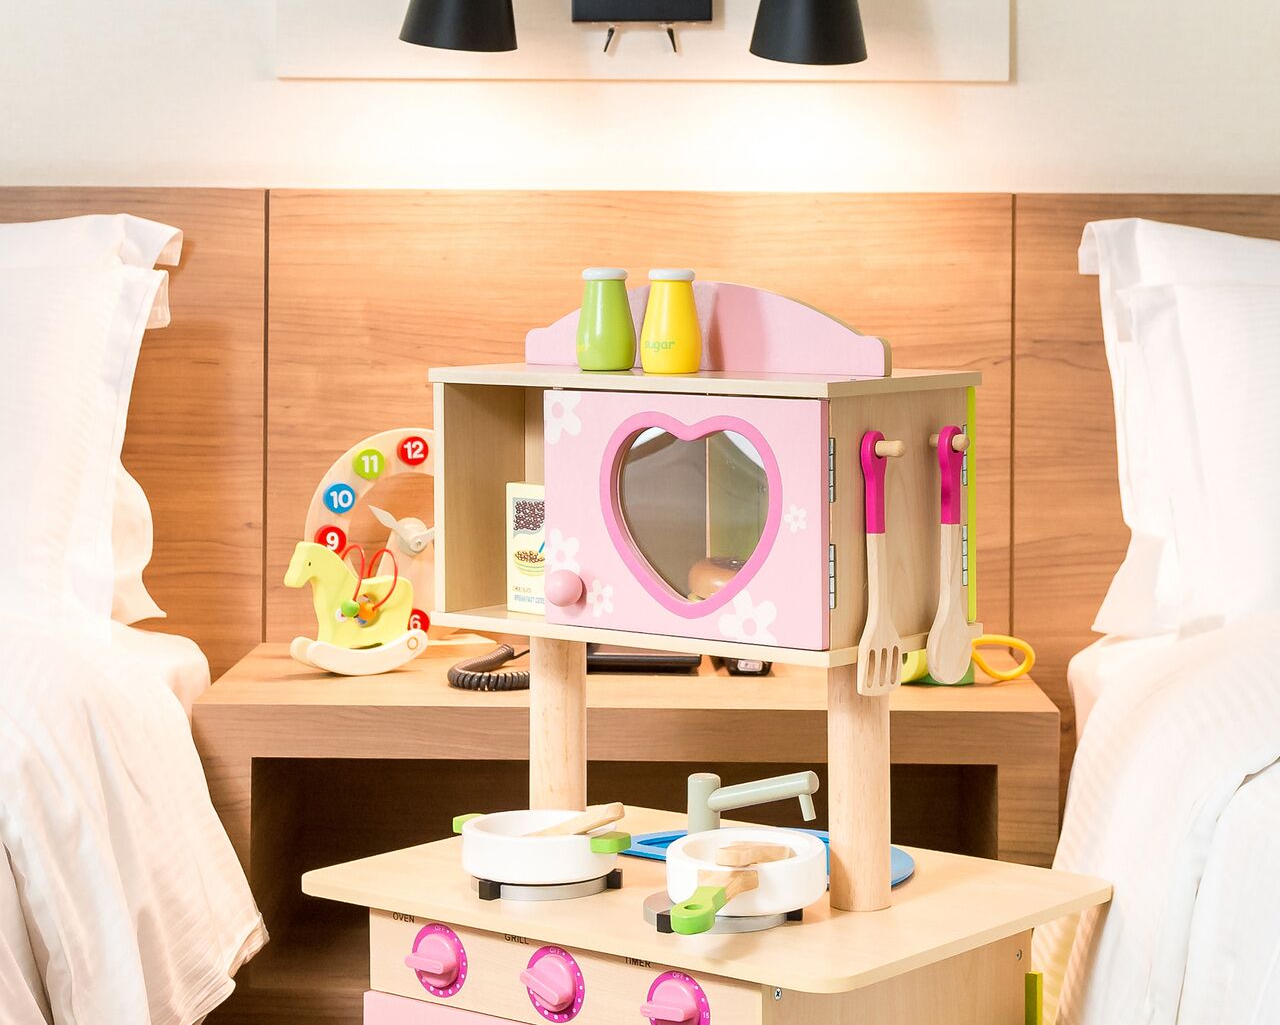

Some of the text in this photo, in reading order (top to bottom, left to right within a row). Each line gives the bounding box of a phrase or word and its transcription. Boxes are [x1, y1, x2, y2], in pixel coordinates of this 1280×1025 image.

[403, 440, 425, 460] 12
[361, 454, 379, 473] 11
[329, 489, 353, 509] 10
[325, 531, 340, 551] 9
[409, 614, 421, 631] 6
[392, 912, 415, 924] OVEN
[504, 933, 529, 945] GRILL
[624, 957, 651, 969] TIMER
[702, 1011, 710, 1019] 15
